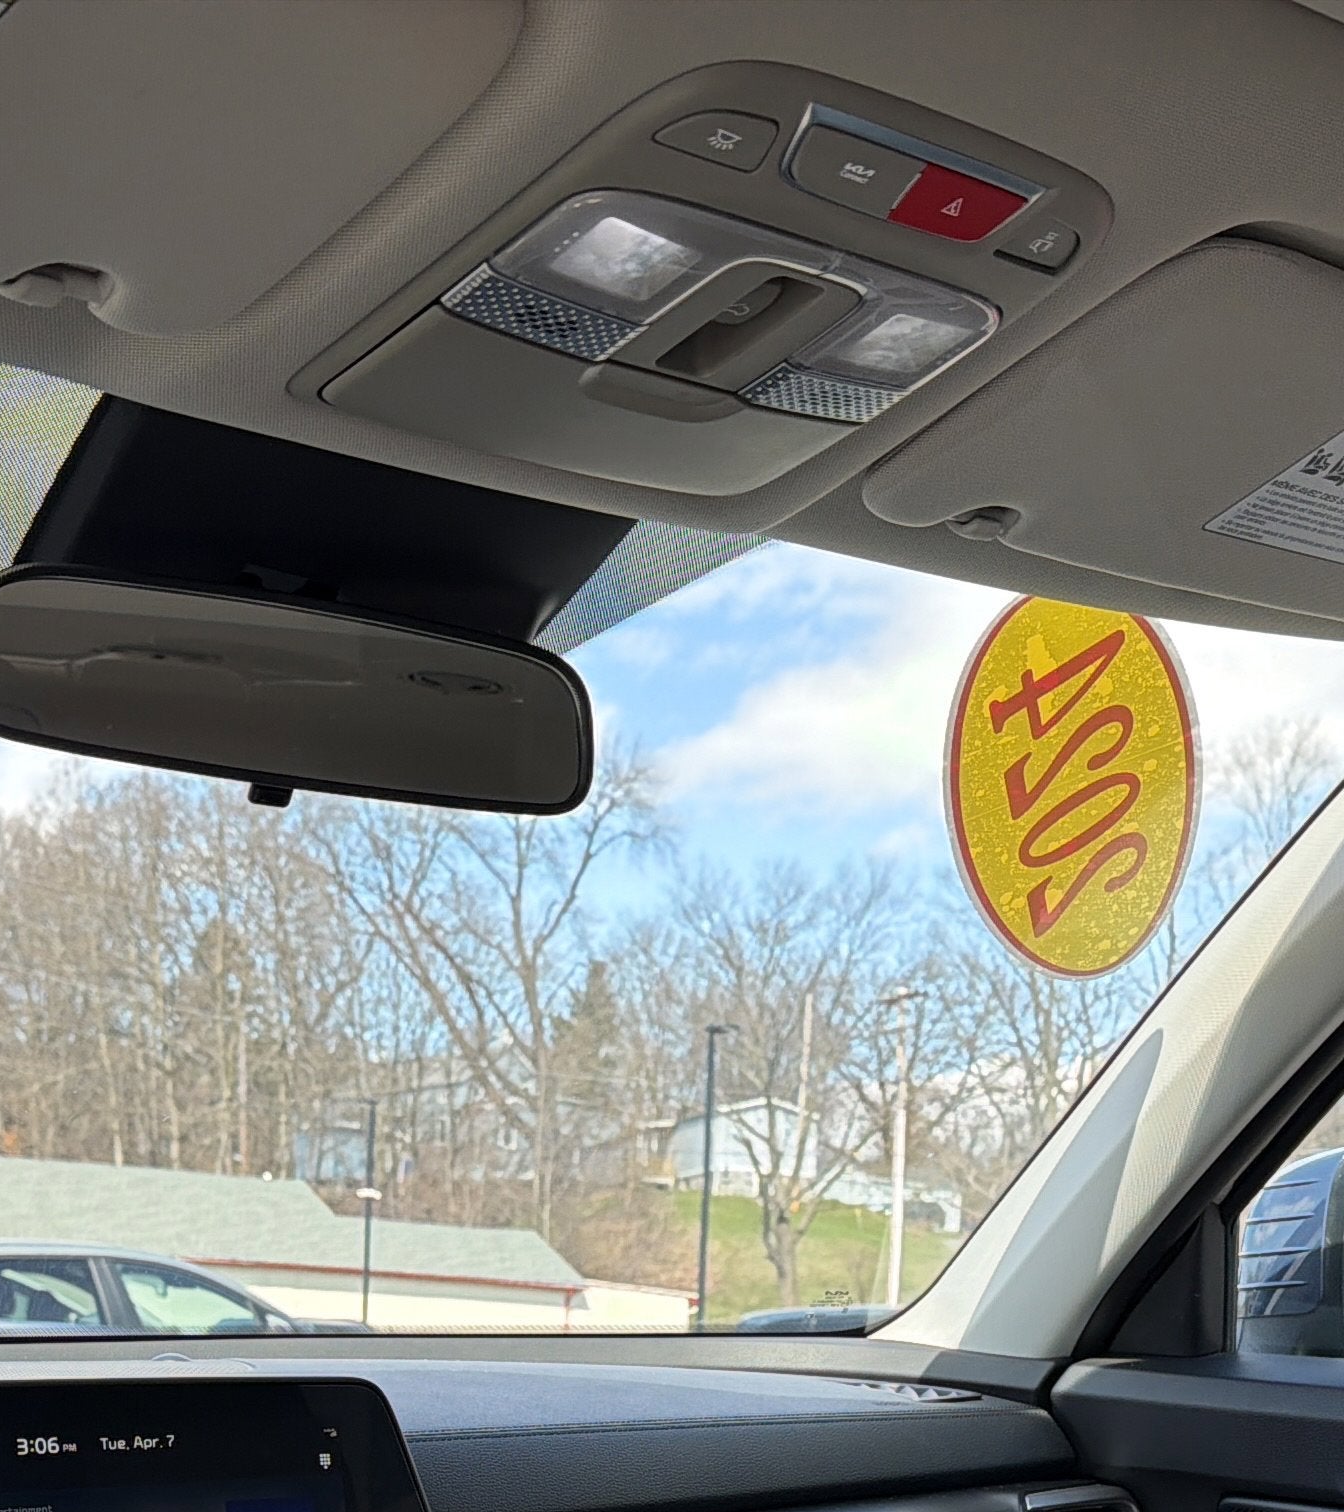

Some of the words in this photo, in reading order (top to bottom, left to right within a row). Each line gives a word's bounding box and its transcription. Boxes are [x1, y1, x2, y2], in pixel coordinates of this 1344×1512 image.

[16, 1436, 60, 1456] 3:06
[62, 1443, 77, 1452] PM
[166, 1434, 175, 1448] 7
